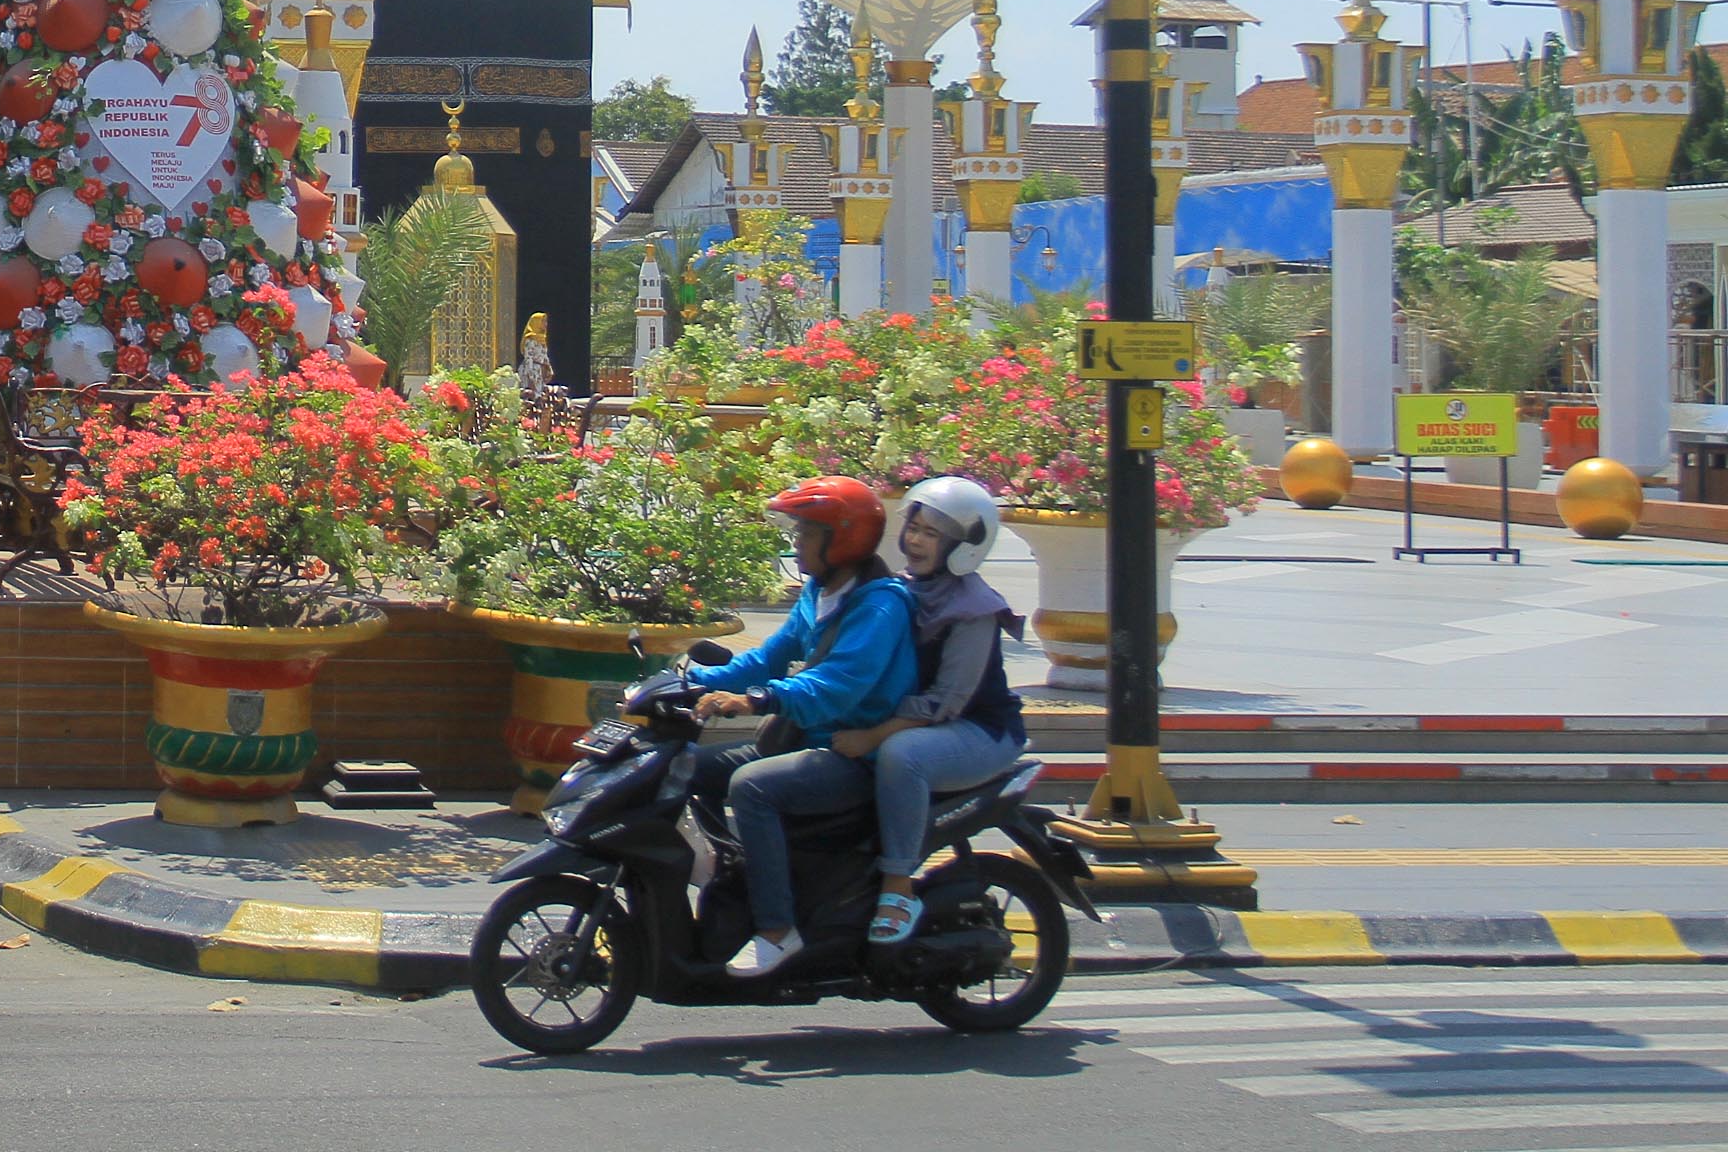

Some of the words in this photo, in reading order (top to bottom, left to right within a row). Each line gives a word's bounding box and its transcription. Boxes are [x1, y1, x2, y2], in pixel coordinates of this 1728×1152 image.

[169, 74, 230, 146] 78
[105, 112, 168, 122] REPUBLIK
[99, 128, 170, 138] INDONESIA
[151, 151, 176, 159] TERUS
[151, 159, 182, 167] MELAJU
[1417, 423, 1460, 437] BATAS
[1464, 423, 1497, 436] SUCI
[1431, 437, 1457, 445] ALAS
[1460, 437, 1484, 445] KAKI
